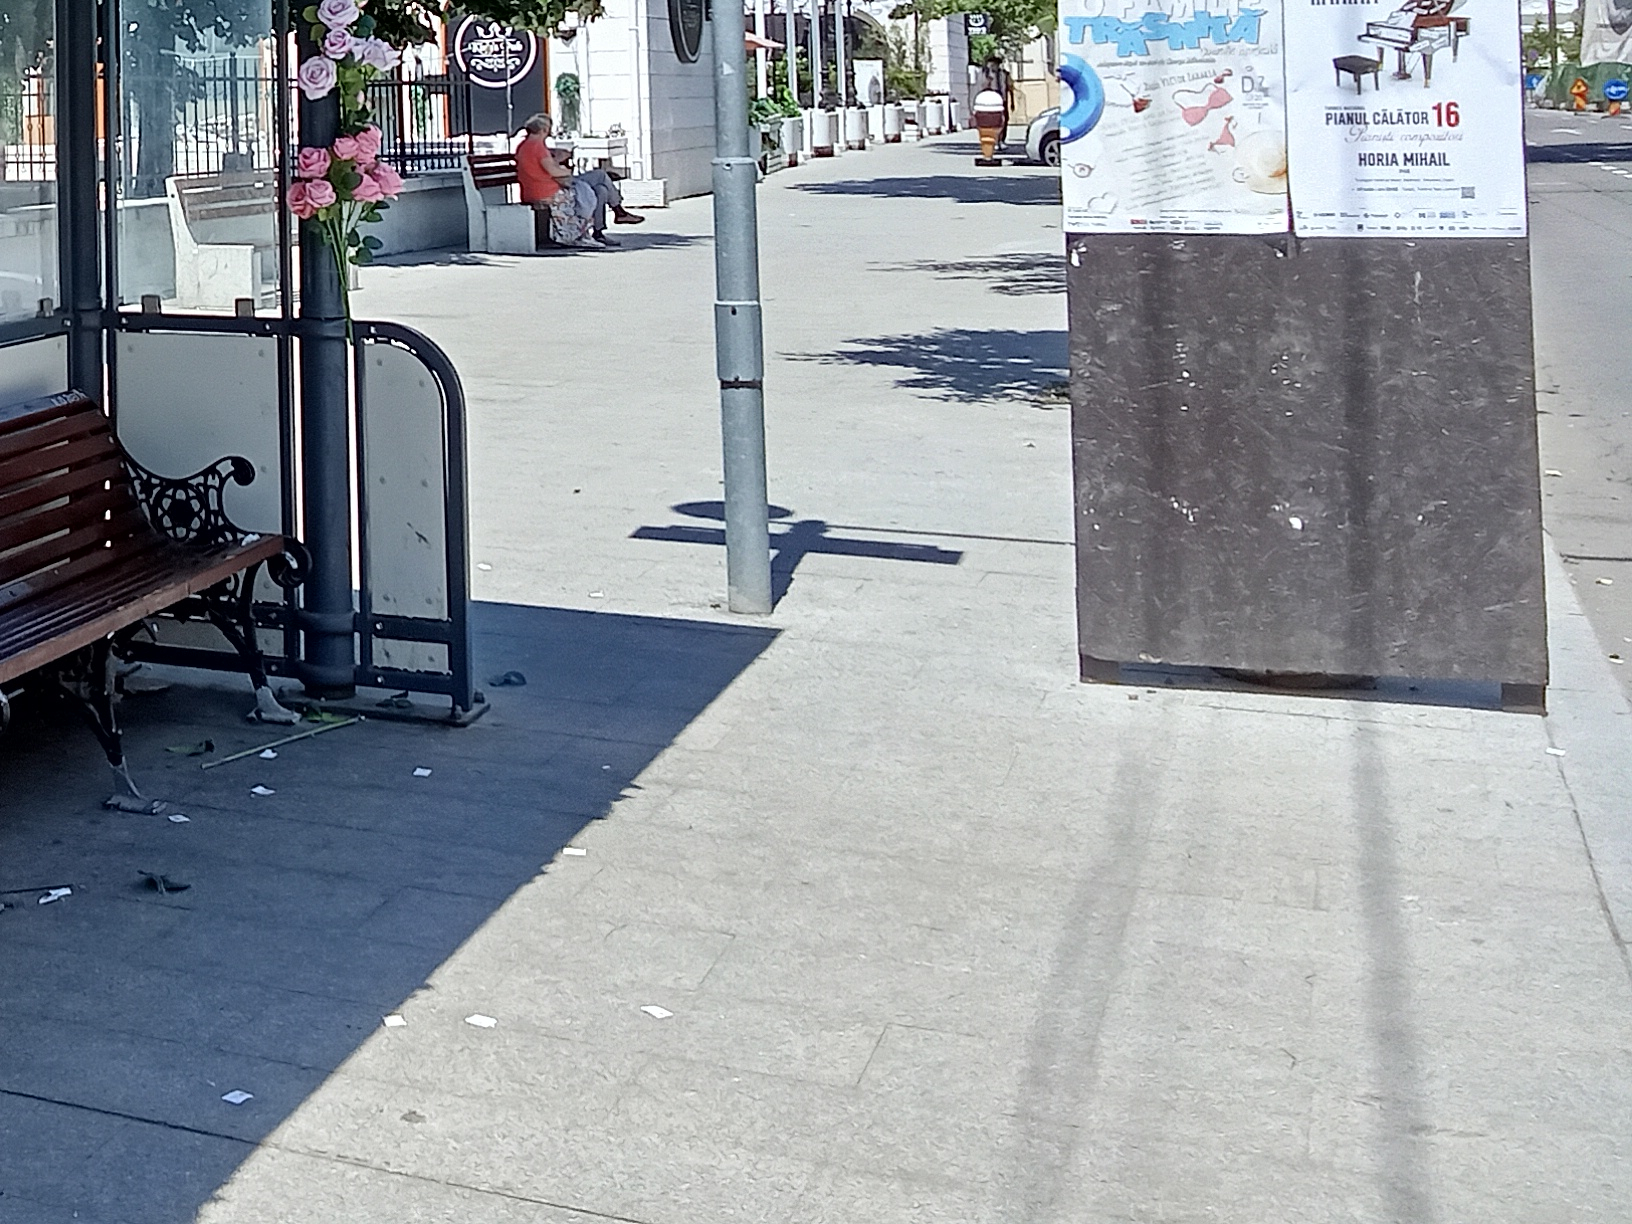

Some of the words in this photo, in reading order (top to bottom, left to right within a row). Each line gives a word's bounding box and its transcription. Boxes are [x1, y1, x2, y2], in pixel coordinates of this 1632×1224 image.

[1325, 112, 1371, 126] PIANUL
[1372, 108, 1429, 125] CĂLĂTOR
[1432, 101, 1460, 127] 16
[1358, 152, 1399, 167] HORIA
[1403, 152, 1451, 167] MIHAIL
